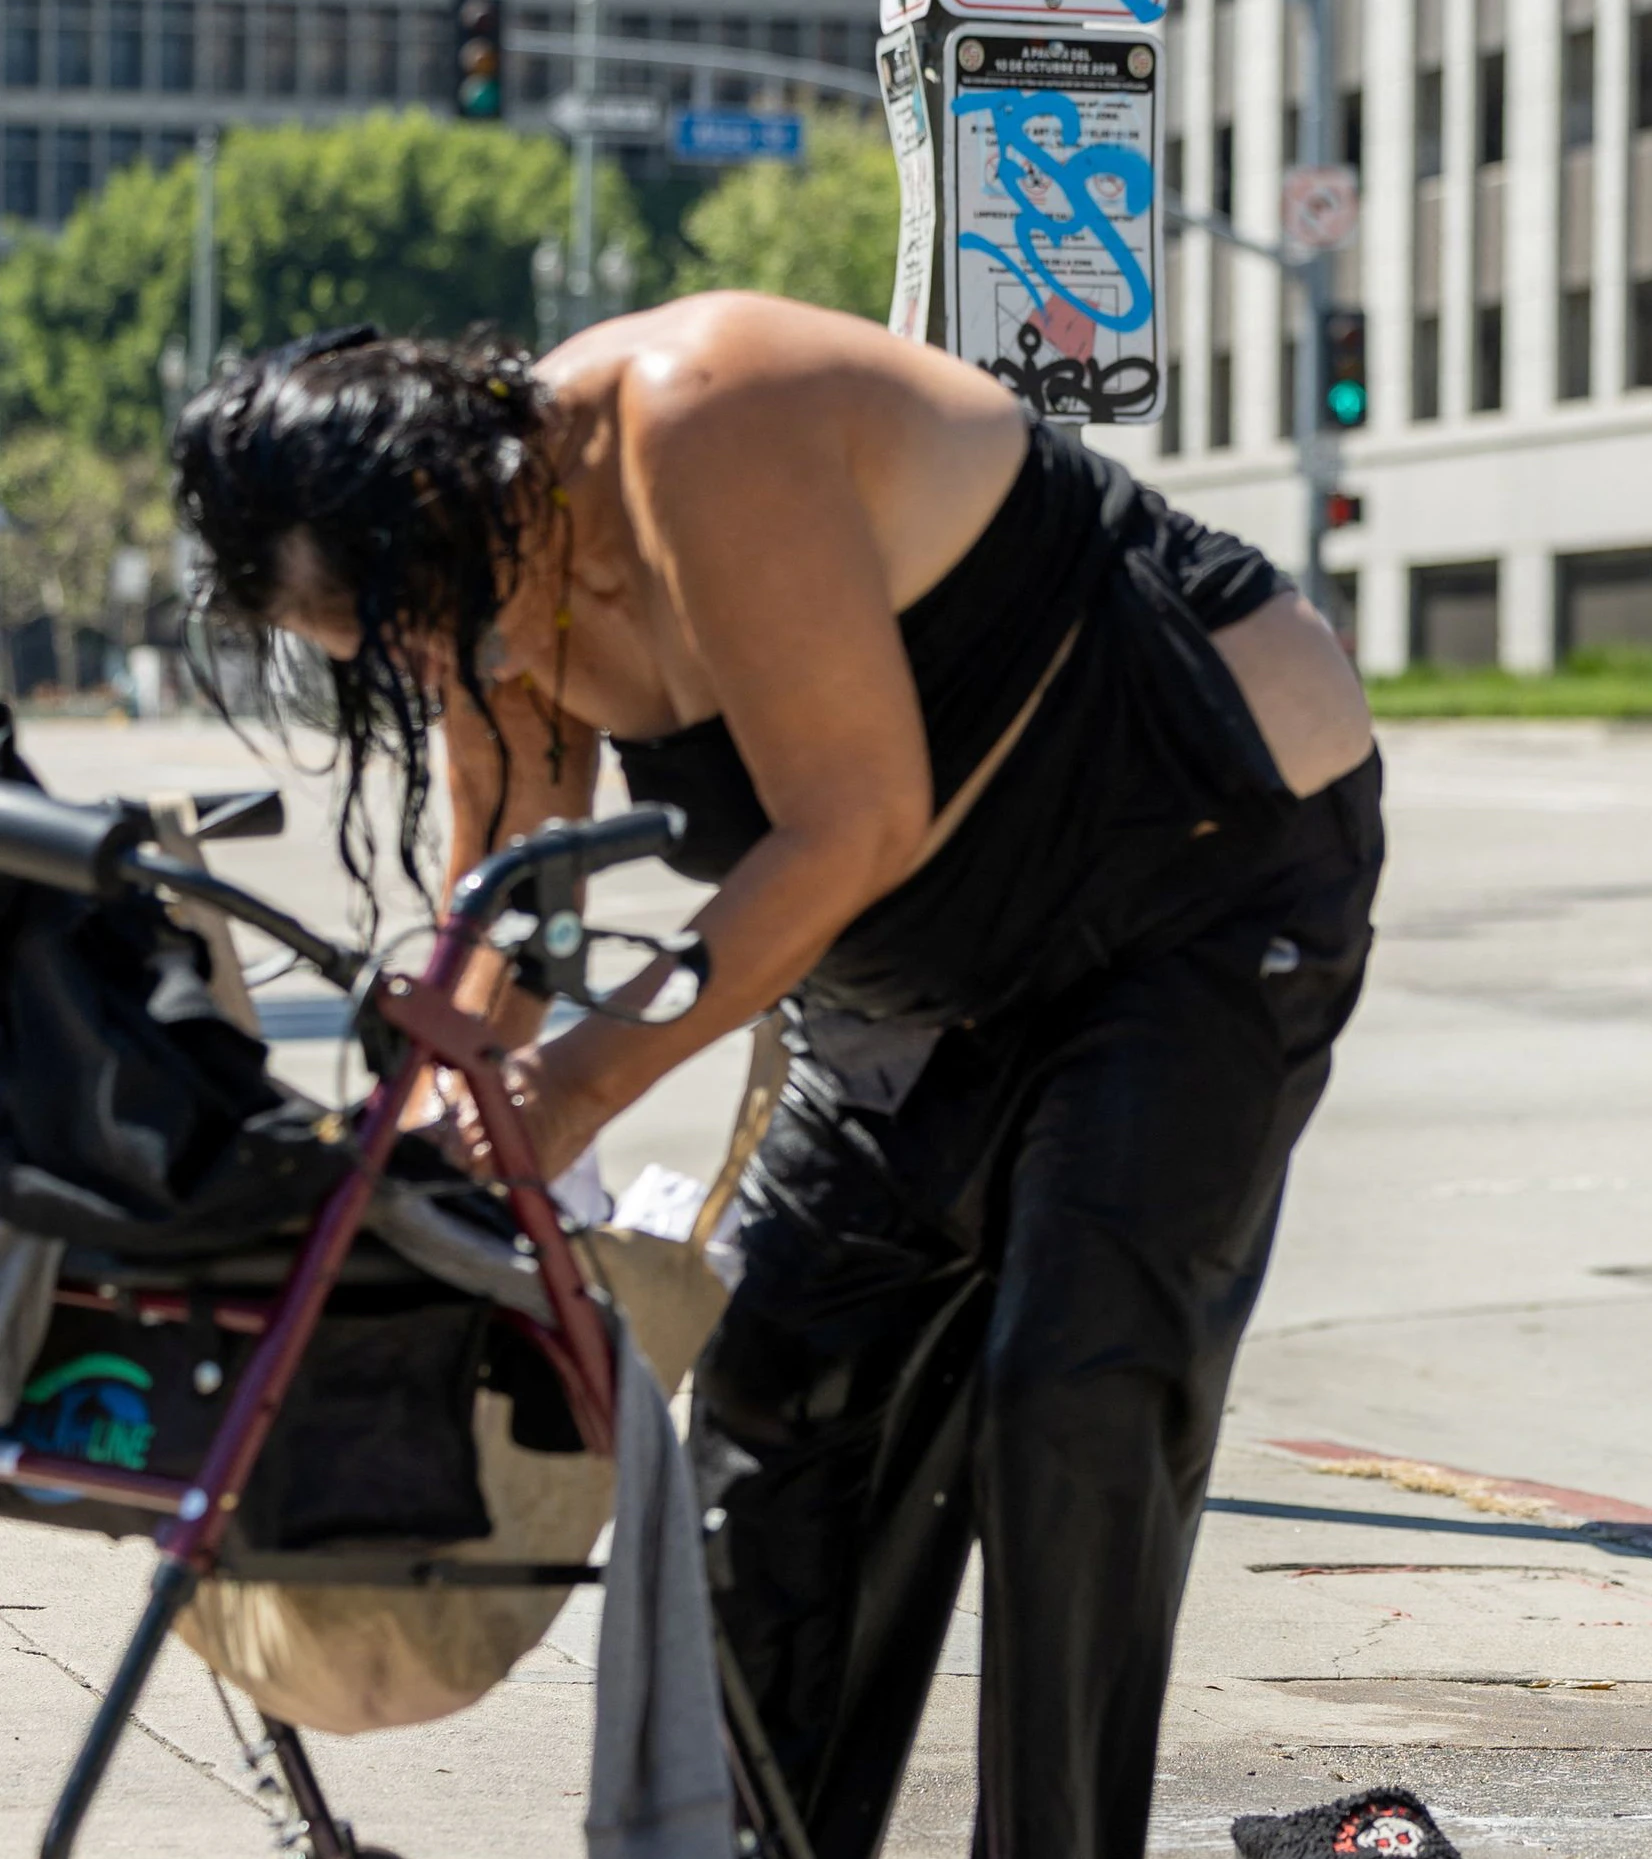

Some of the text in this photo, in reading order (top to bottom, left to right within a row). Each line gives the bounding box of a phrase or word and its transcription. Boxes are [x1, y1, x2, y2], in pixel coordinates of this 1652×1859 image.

[1070, 48, 1093, 62] DEL
[1009, 60, 1023, 72] DE
[1024, 61, 1074, 75] OCTUBRE
[1077, 63, 1090, 75] DE
